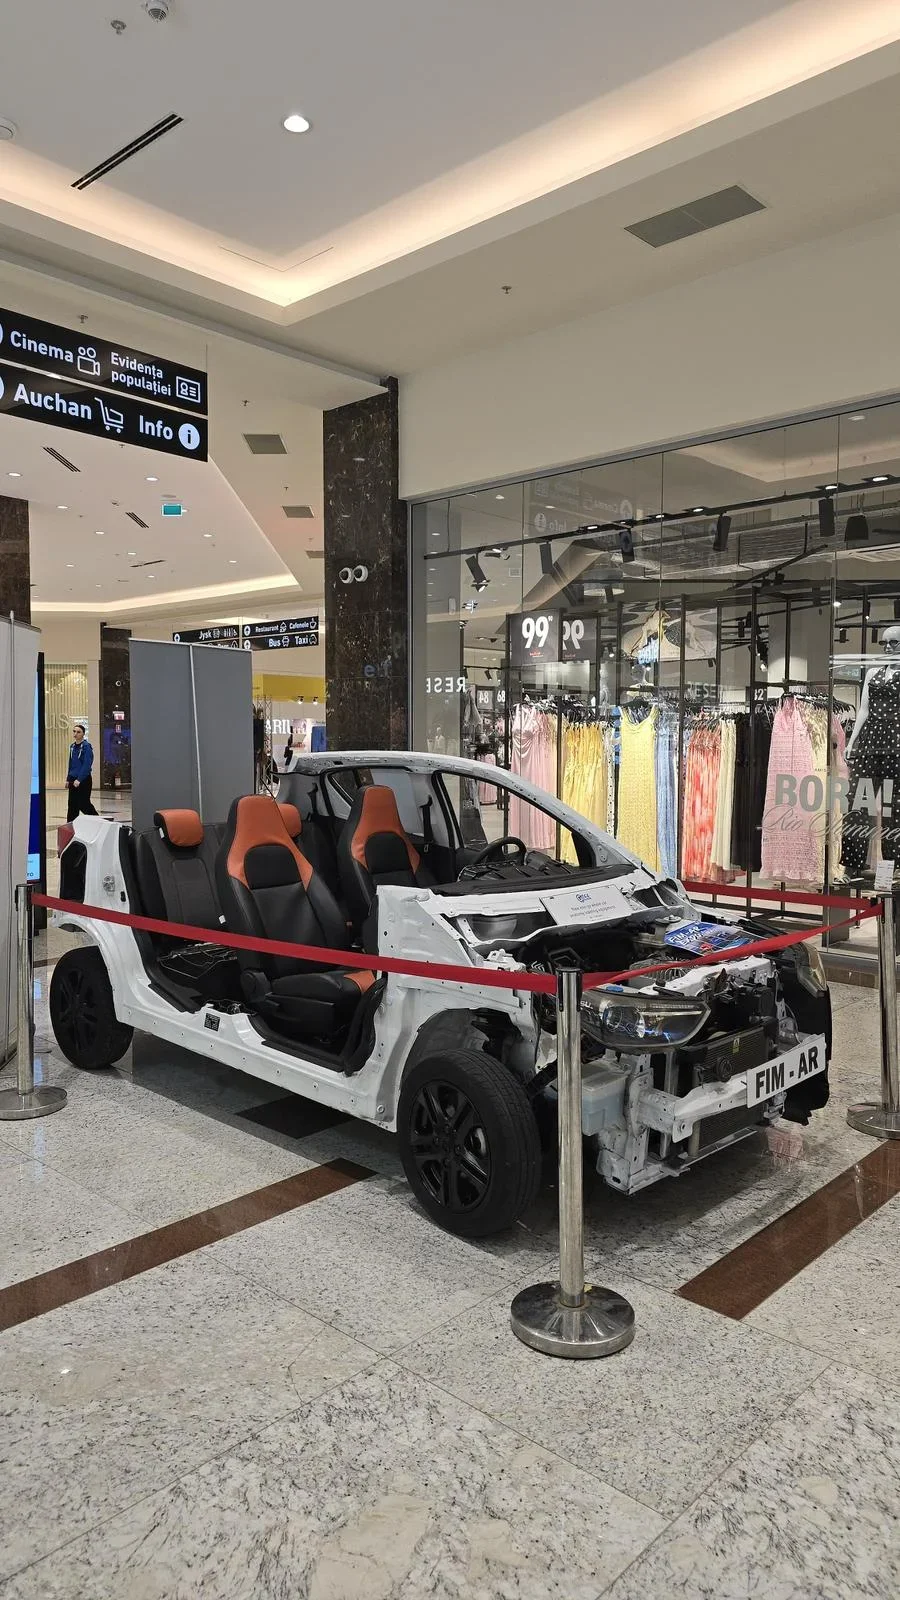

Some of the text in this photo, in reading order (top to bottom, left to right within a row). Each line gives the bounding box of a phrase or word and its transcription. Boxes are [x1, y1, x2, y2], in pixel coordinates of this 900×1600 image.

[10, 330, 74, 363] Cinema
[110, 351, 163, 380] Evidența
[111, 370, 171, 396] populației
[14, 383, 92, 420] Auchan
[139, 415, 173, 440] Info
[199, 630, 212, 640] Jysk
[255, 624, 279, 633] Restaurant
[268, 635, 309, 648] Bus Taxi
[521, 615, 549, 649] 99
[774, 773, 894, 818] BORA!
